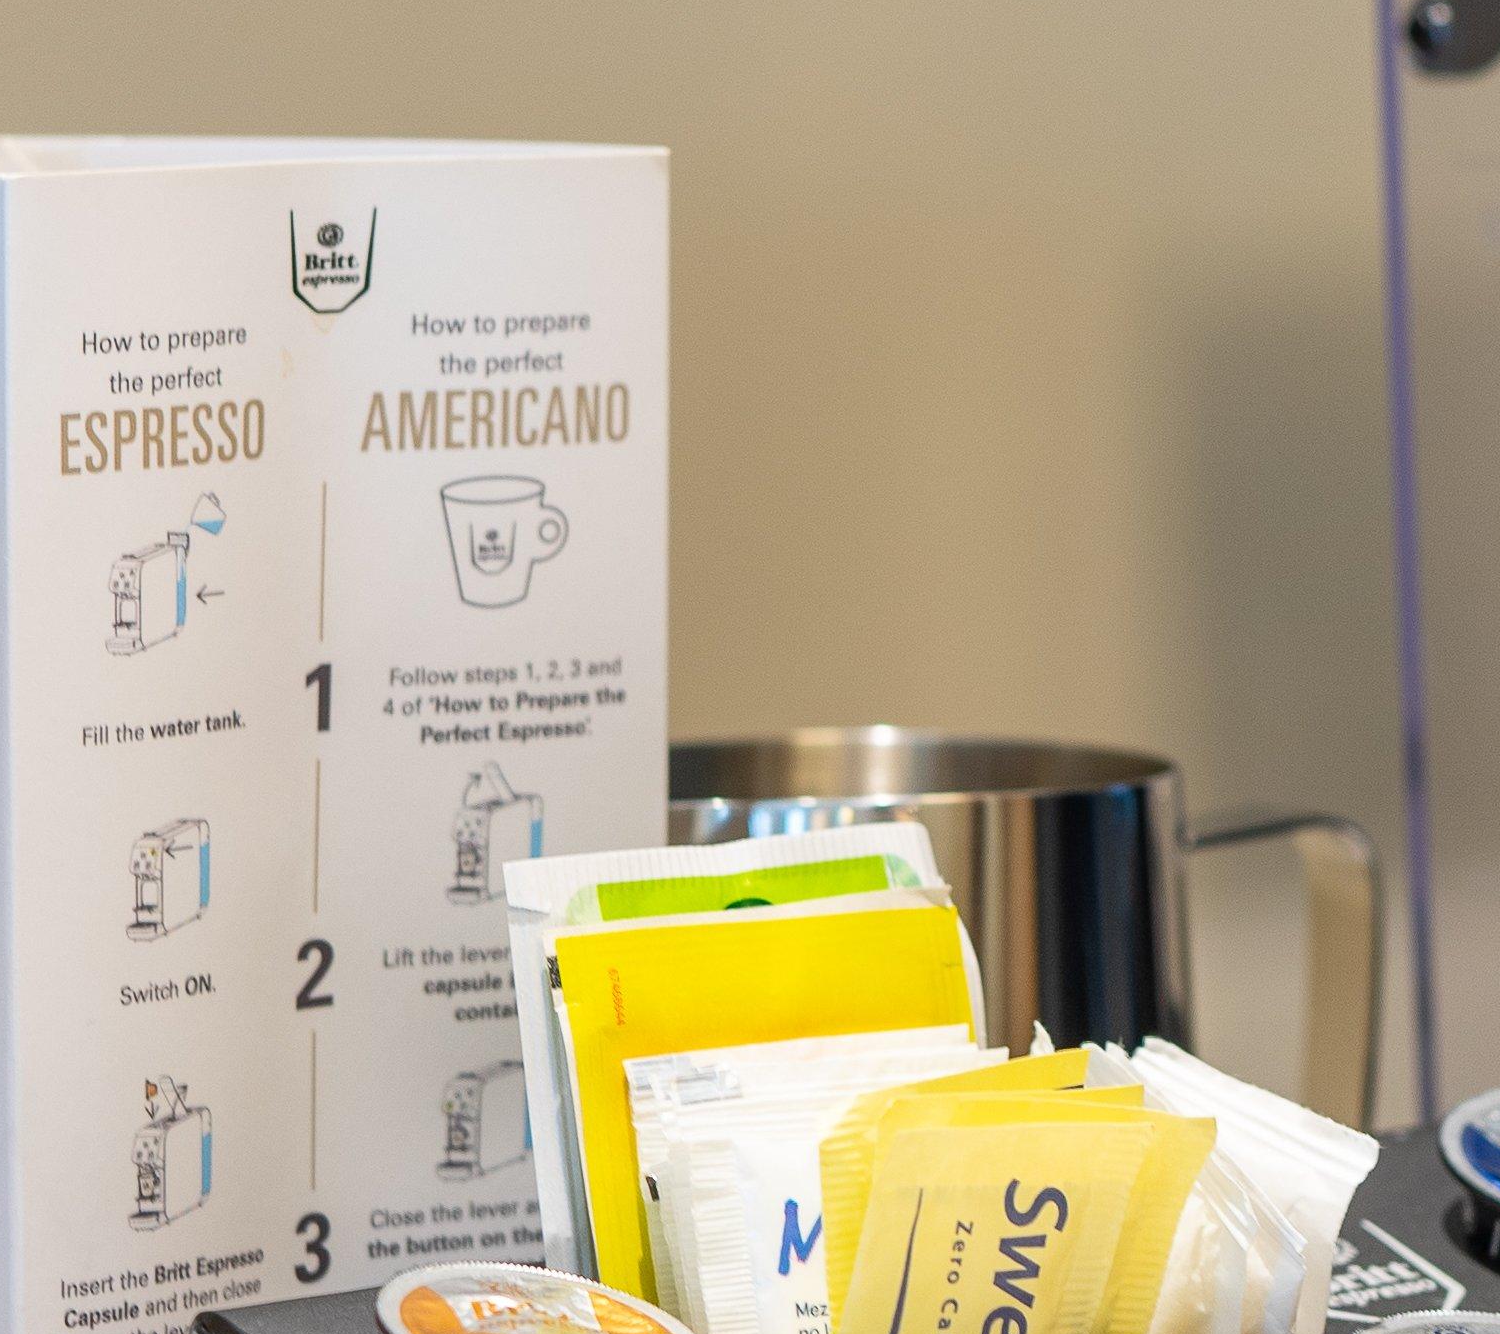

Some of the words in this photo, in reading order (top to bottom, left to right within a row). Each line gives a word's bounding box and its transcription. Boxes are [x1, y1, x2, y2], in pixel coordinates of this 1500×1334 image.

[305, 251, 354, 270] Britt
[82, 331, 132, 355] How
[140, 331, 160, 351] to
[168, 327, 247, 353] prepare
[411, 313, 465, 336] How
[474, 314, 496, 335] to
[504, 313, 591, 338] prepare
[440, 353, 477, 375] the
[485, 349, 563, 377] perfect
[110, 369, 143, 394] the
[151, 365, 223, 396] perfect
[360, 381, 631, 453] AMERICANO
[60, 398, 266, 476] ESPRESSO
[390, 666, 458, 686] Follow
[464, 665, 518, 685] steps
[588, 655, 623, 677] and
[305, 662, 332, 732] 1
[383, 698, 394, 716] 4
[402, 695, 422, 716] of
[489, 693, 510, 712] to
[515, 689, 589, 712] Prepare
[596, 683, 626, 705] the
[82, 725, 109, 746] Fill
[115, 722, 144, 743] the
[150, 717, 200, 739] water
[206, 709, 246, 732] tank.
[420, 722, 490, 744] Perfect
[383, 945, 414, 968] Lift
[421, 945, 454, 965] the
[120, 980, 179, 1006] Switch
[185, 973, 216, 996] ON.
[296, 938, 335, 1011] 2
[423, 971, 502, 999] capsule
[370, 1209, 425, 1229] Close
[431, 1204, 463, 1223] the
[469, 1200, 518, 1218] lever
[295, 1213, 331, 1284] 3
[368, 1238, 400, 1259] the
[406, 1233, 473, 1254] button
[480, 1232, 506, 1248] on
[947, 1220, 974, 1285] Zero
[60, 1273, 115, 1299] Insert
[119, 1269, 149, 1291] the
[154, 1262, 191, 1284] Britt
[196, 1248, 264, 1277] Espresso
[1330, 1261, 1422, 1293] ritt
[64, 1302, 140, 1329] Capsule
[144, 1293, 178, 1317] and
[183, 1287, 219, 1311] then
[222, 1277, 262, 1303] close
[795, 1302, 830, 1318] Mez
